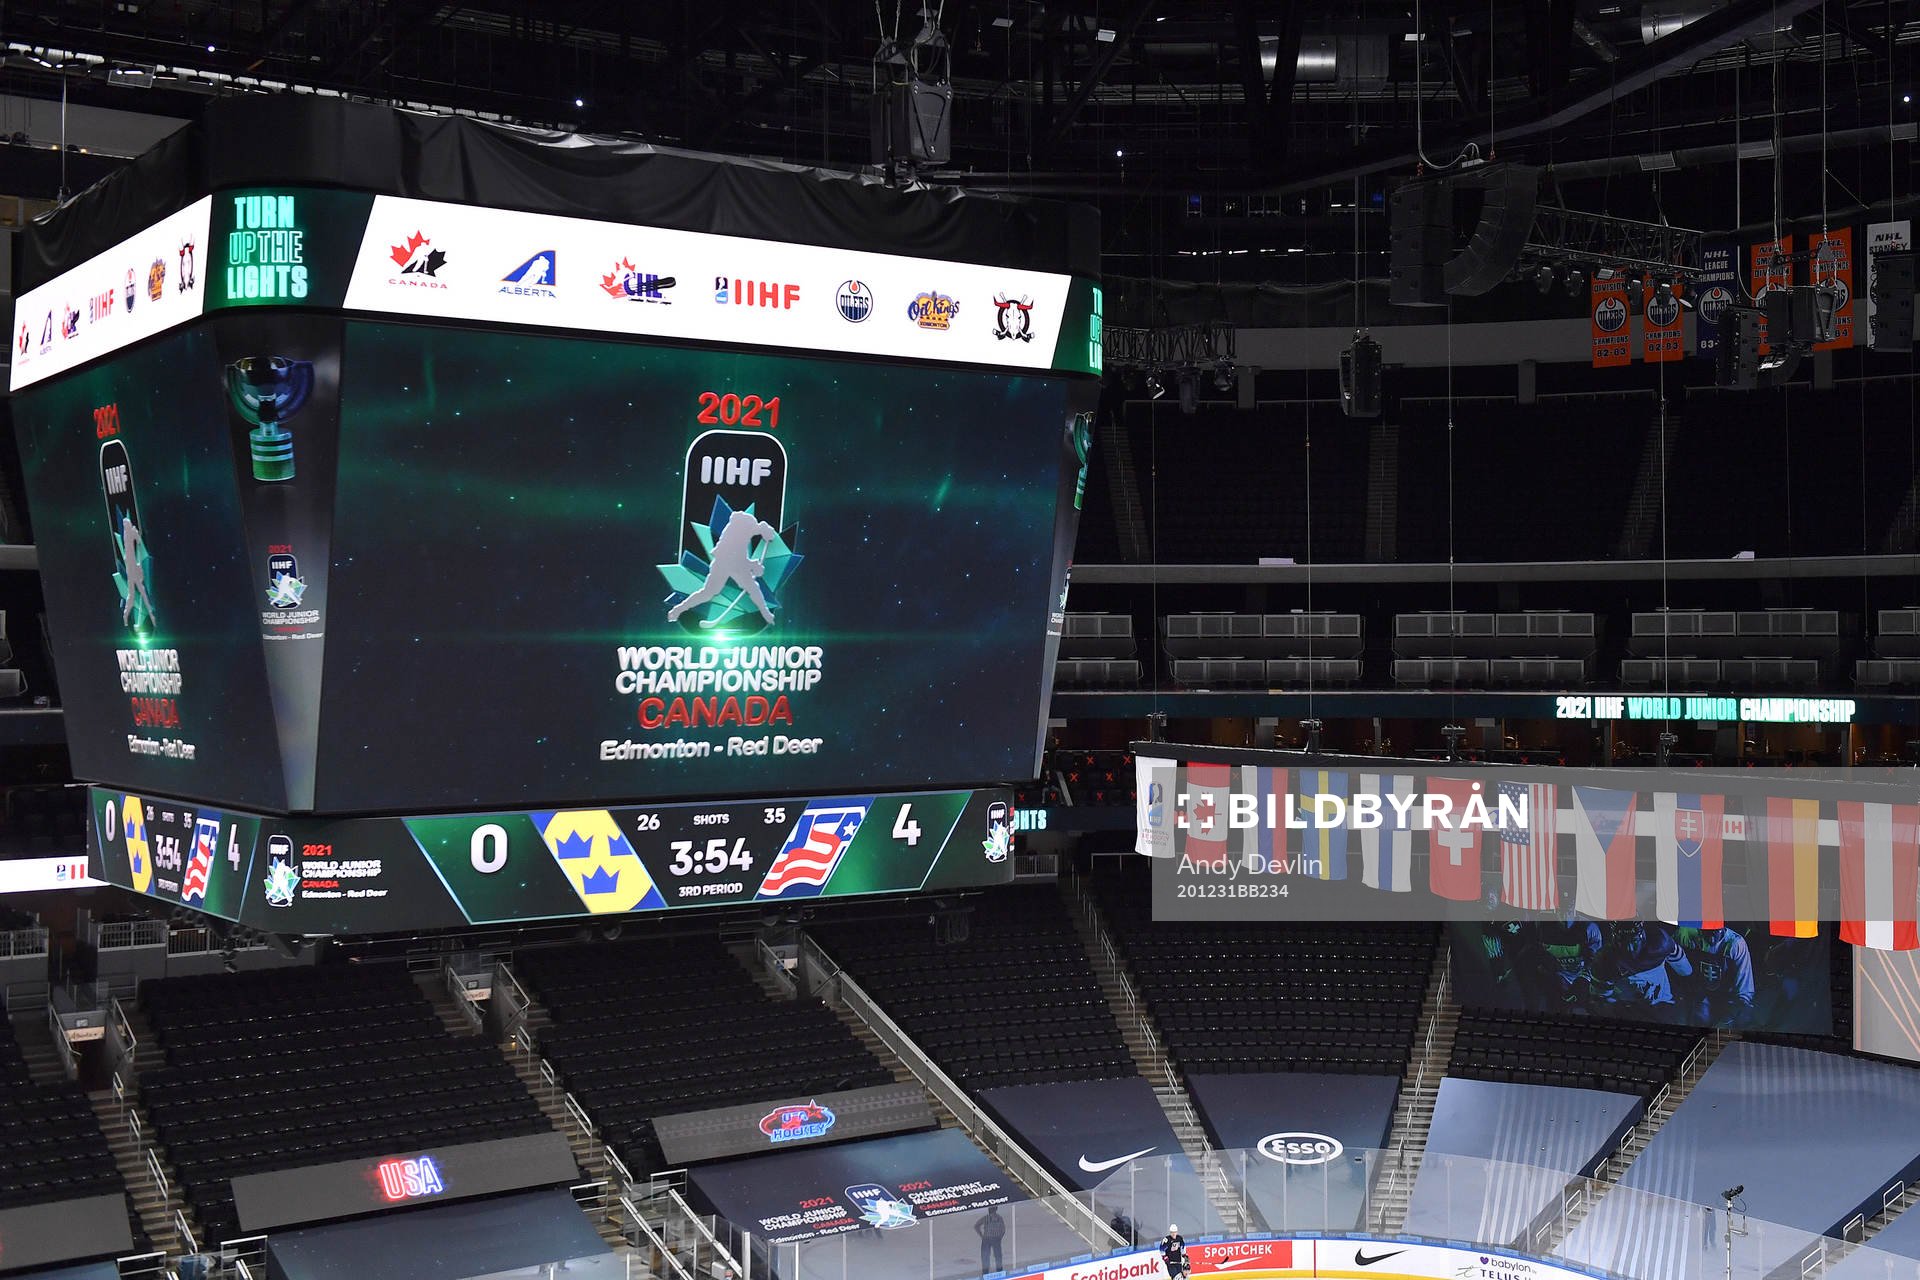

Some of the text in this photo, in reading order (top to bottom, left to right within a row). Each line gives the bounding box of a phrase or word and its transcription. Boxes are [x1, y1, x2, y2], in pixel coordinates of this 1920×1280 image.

[234, 195, 295, 229] TURN
[1875, 233, 1902, 241] NHL
[230, 231, 303, 264] UP THE
[1704, 250, 1729, 259] NHL
[1705, 261, 1728, 270] LEAGUE
[227, 266, 308, 299] LIGHTS
[388, 278, 448, 289] CANADA
[1700, 272, 1735, 282] CHAMPIONS
[498, 286, 556, 298] ALBERTA
[734, 279, 800, 310] IIHF
[1594, 335, 1628, 345] CHAMPIONS
[1645, 330, 1681, 340] CHAMPIONS
[697, 392, 779, 428] 2021
[93, 403, 121, 439] 2021
[105, 464, 129, 495] IIHF
[701, 456, 772, 486] IIHF
[271, 561, 292, 569] IIHF
[287, 610, 319, 618] JUNIOR
[617, 646, 823, 671] WORLD JUNIOR
[615, 668, 822, 694] CHAMPIONSHIP
[638, 695, 794, 729] CANADA
[1556, 697, 1856, 723] 2021 IIHF WORLD JUNIOR CHAMPIONSHIP
[600, 738, 710, 761] Edmonton
[727, 736, 768, 757] Red
[773, 736, 823, 755] Deer
[105, 800, 115, 841] 0
[637, 808, 786, 831] 26 SHOTS 35
[892, 803, 921, 846] 4
[155, 834, 181, 872] 3:54
[228, 823, 239, 871] 4
[303, 844, 333, 856] 2021
[470, 823, 508, 873] 0
[302, 860, 381, 870] WORLD JUNIOR
[668, 837, 753, 877] 3:54
[302, 868, 381, 878] CHAMPIONSHIP
[302, 880, 339, 888] CANADA
[678, 882, 743, 897] 3RD PERIOD
[773, 1124, 826, 1140] HOCKEY
[380, 1158, 443, 1199] USA
[899, 1180, 933, 1191] 2021
[851, 1188, 882, 1199] IIHF
[908, 1181, 982, 1199] CHAMPIONNAT
[911, 1183, 1001, 1205] MONDIAL JUNIOR
[799, 1197, 834, 1209] 2021
[919, 1200, 959, 1211] CANADA
[925, 1205, 967, 1217] Edmonton
[972, 1199, 989, 1208] Red
[989, 1196, 1009, 1206] Deer
[758, 1205, 845, 1227] WORLD JUNIOR
[763, 1210, 848, 1231] CHAMPIONSHIP
[812, 1218, 856, 1229] CANADA
[820, 1226, 843, 1236] Red
[844, 1223, 860, 1233] Deer
[1480, 1269, 1520, 1280] TELUS
[1491, 1258, 1531, 1272] babylon
